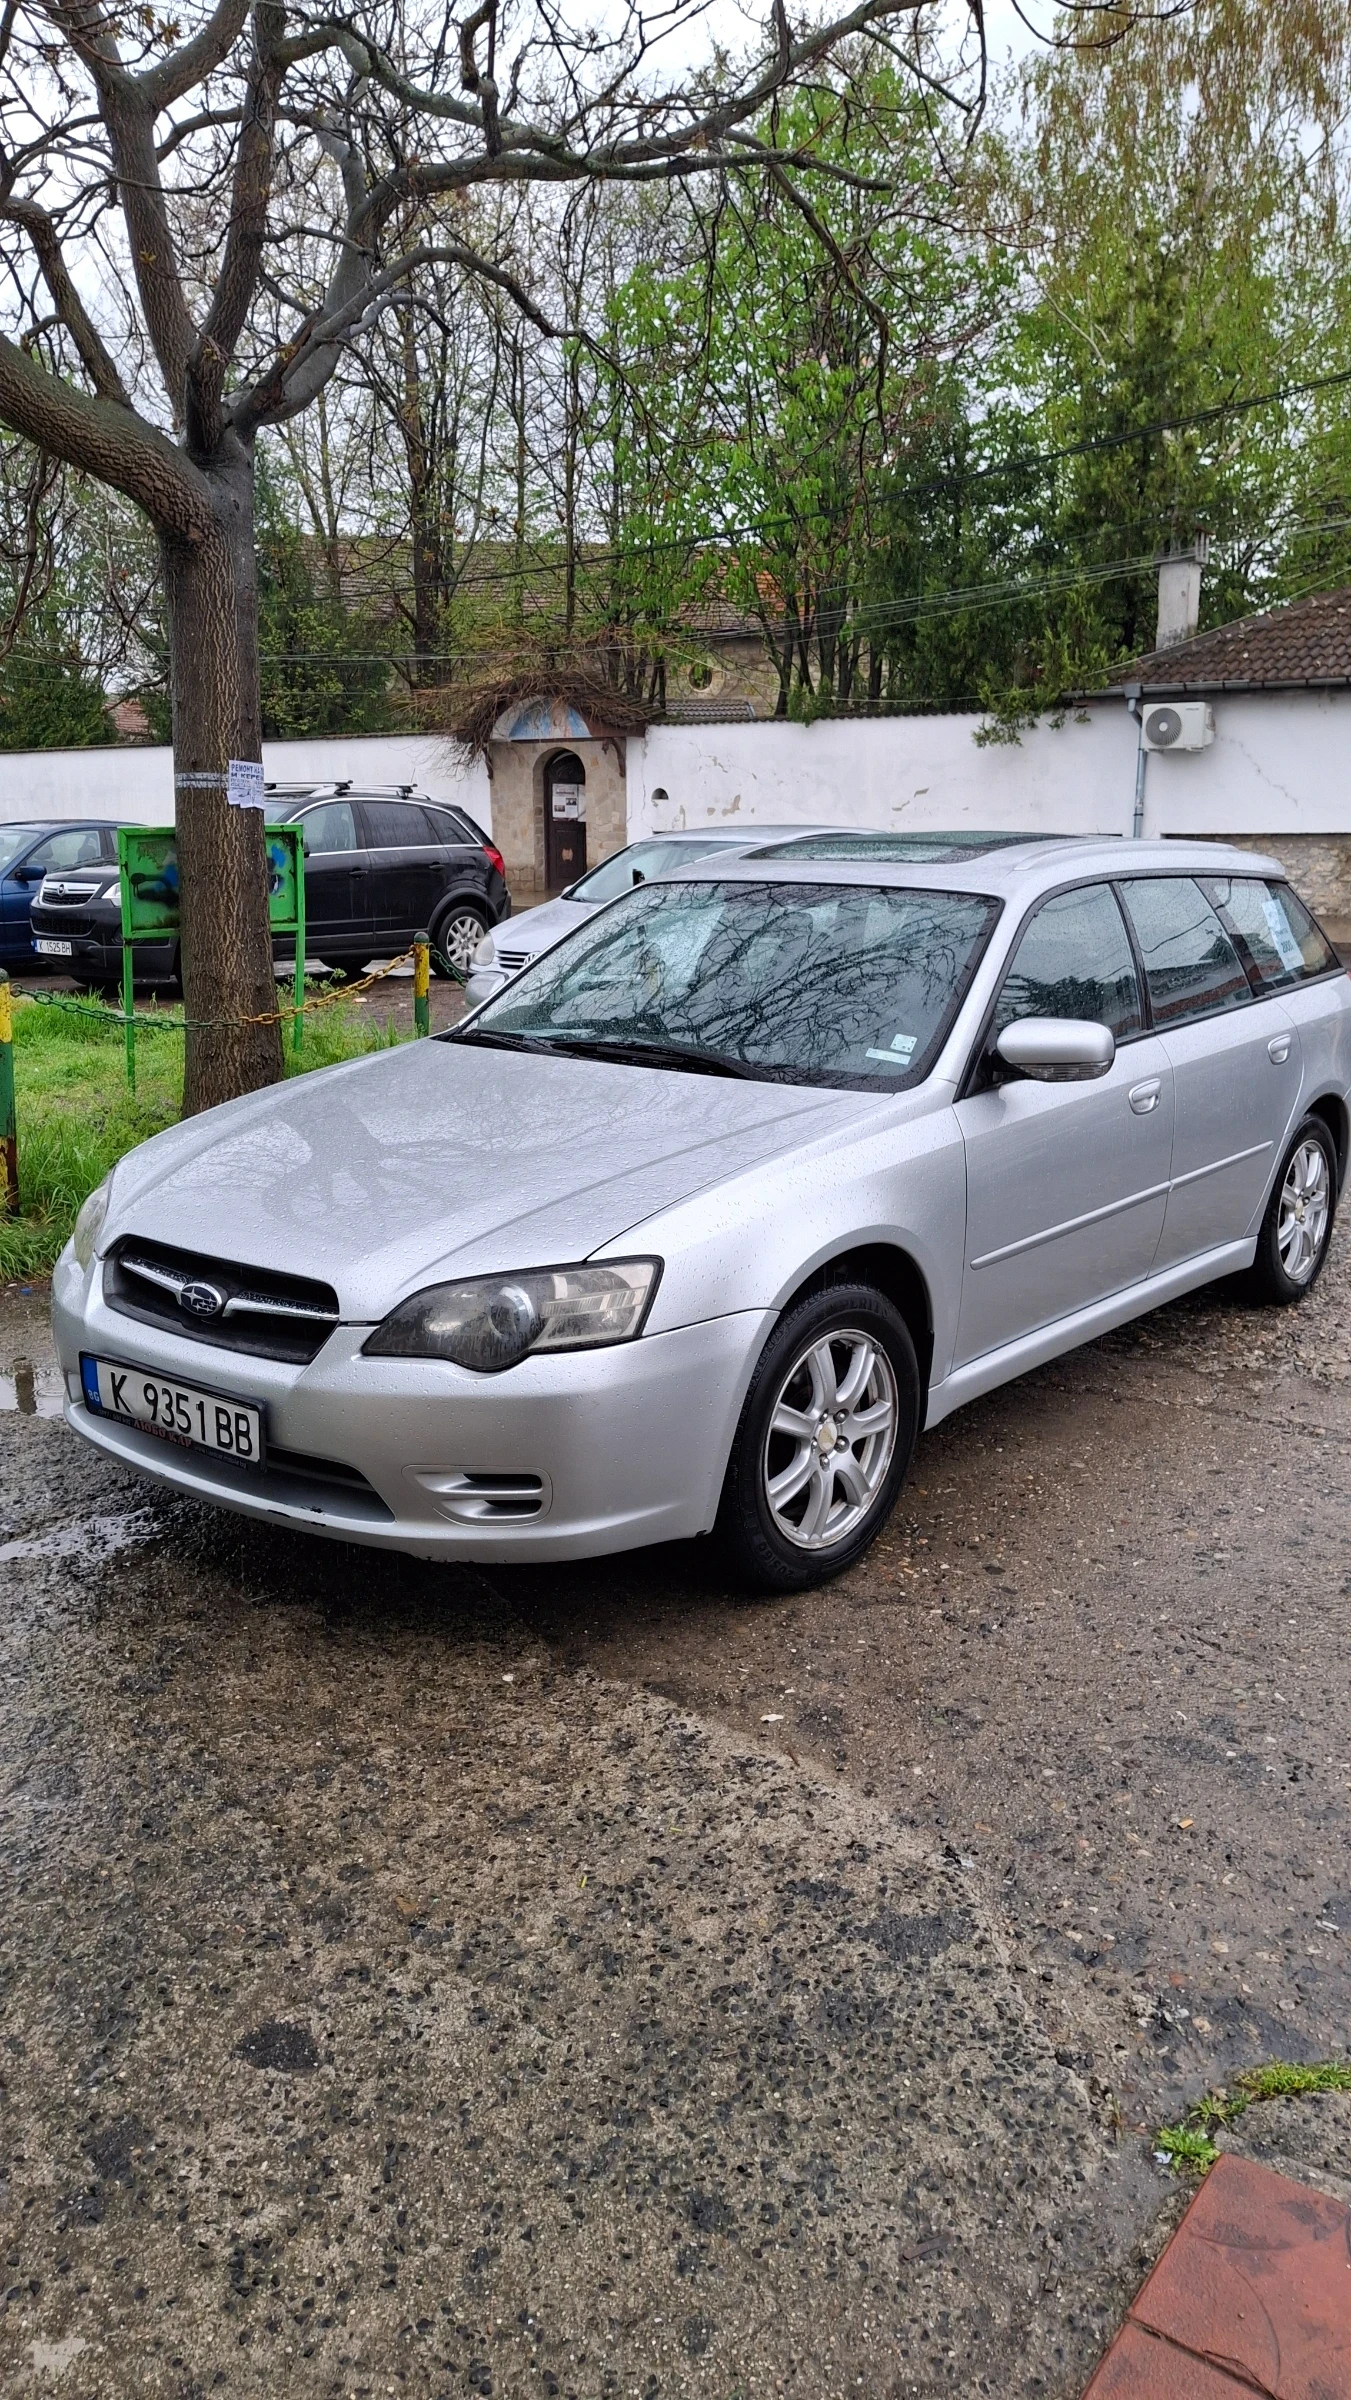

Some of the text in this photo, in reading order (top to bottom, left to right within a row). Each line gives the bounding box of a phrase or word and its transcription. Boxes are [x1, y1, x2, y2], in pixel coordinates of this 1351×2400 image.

[231, 764, 253, 773] РЕМОНТ
[46, 942, 60, 952] 1525
[62, 942, 70, 953] BH
[88, 1389, 100, 1402] BG
[111, 1371, 252, 1456] K 9351 BB
